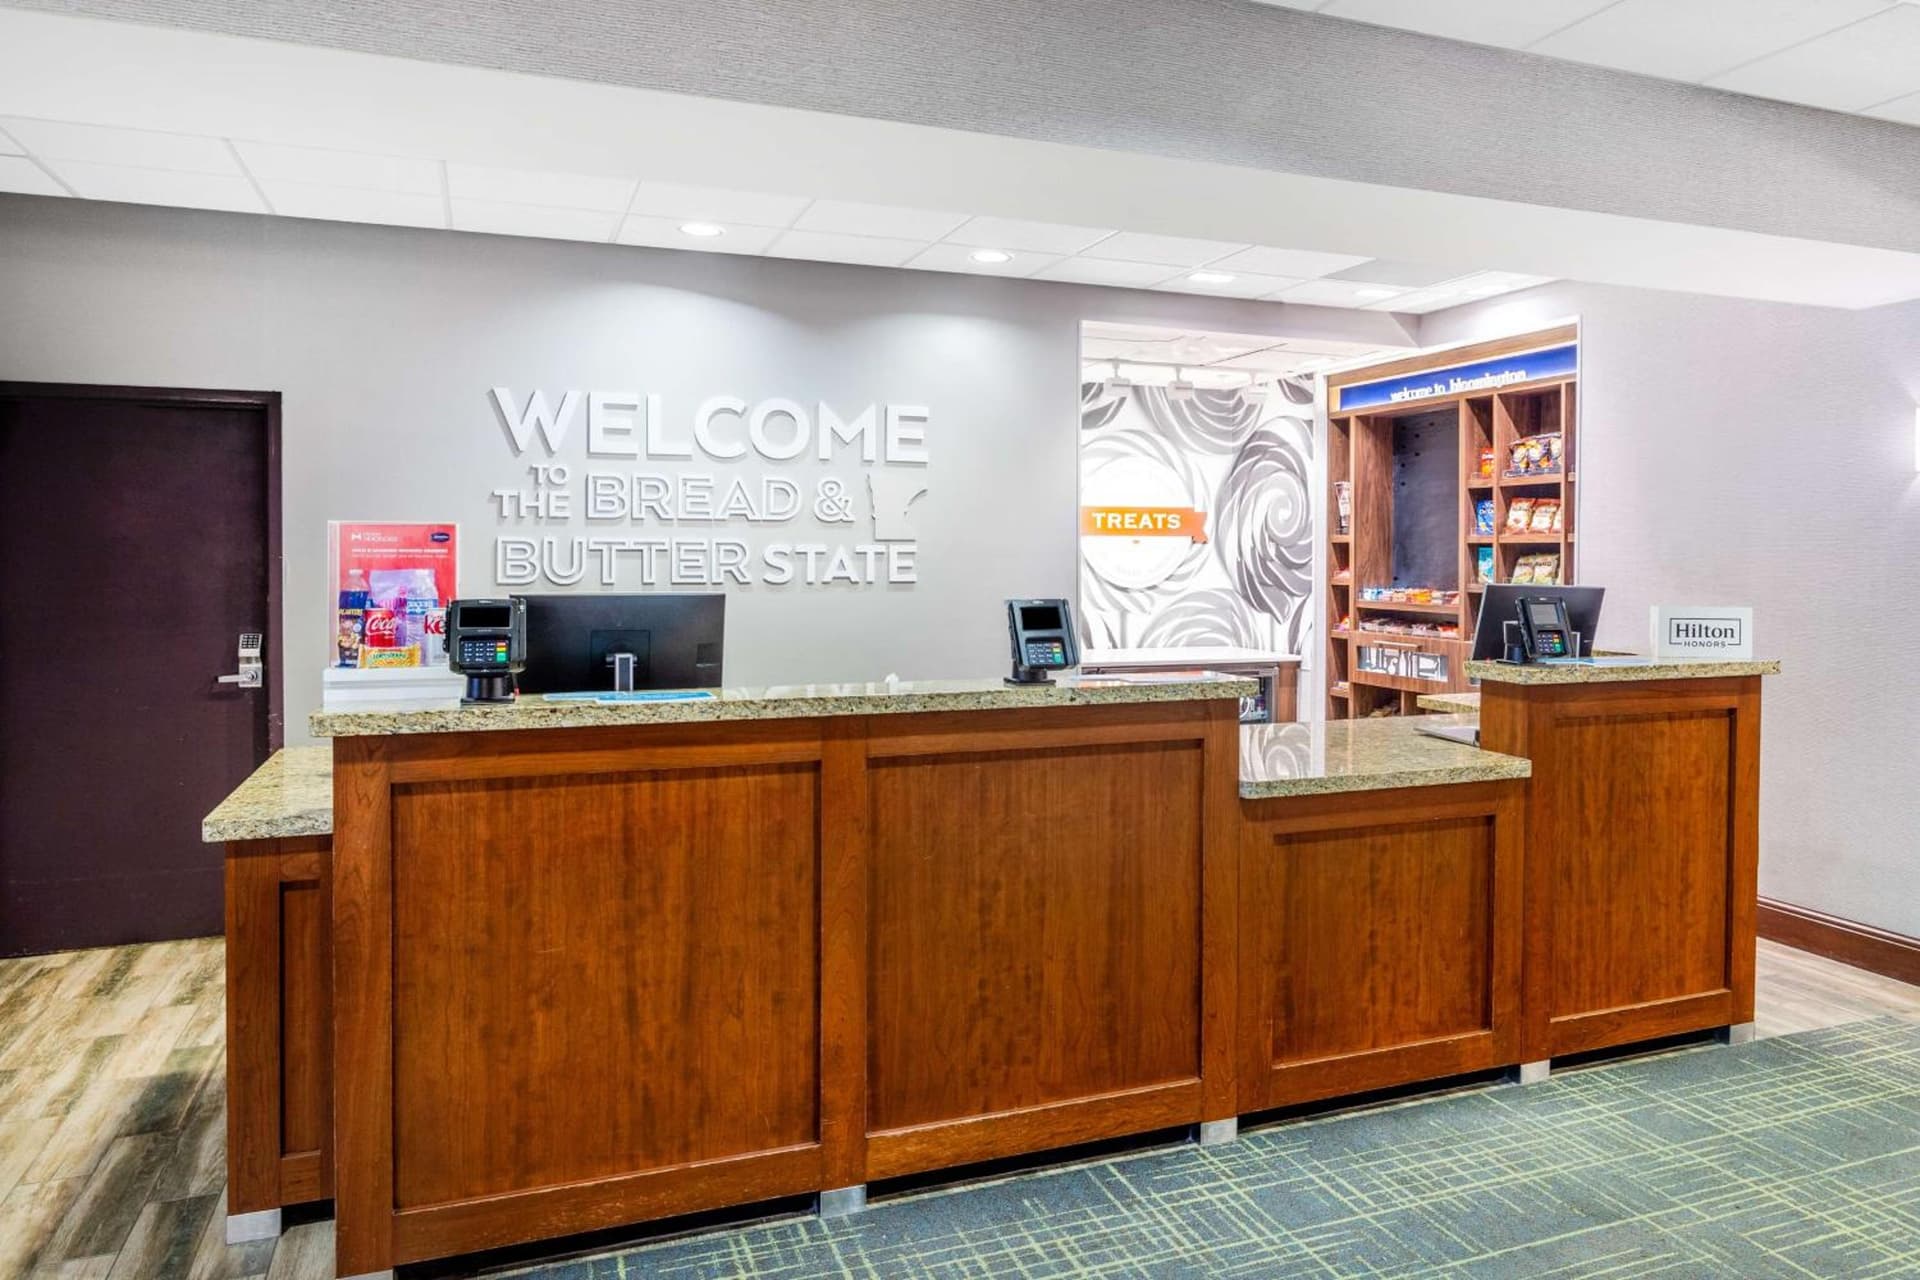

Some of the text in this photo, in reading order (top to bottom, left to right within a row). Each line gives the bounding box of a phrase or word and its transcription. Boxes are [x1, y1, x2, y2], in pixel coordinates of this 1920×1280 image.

[1390, 370, 1526, 400] welcome to bloomington
[488, 387, 930, 464] WELCOME
[530, 464, 570, 486] TO
[491, 489, 572, 520] THE
[585, 472, 856, 523] BREAD &
[1091, 512, 1182, 530] TREATS
[496, 535, 918, 586] BUTTER STATE
[1675, 623, 1735, 639] Hilton
[1683, 640, 1727, 648] HONORS
